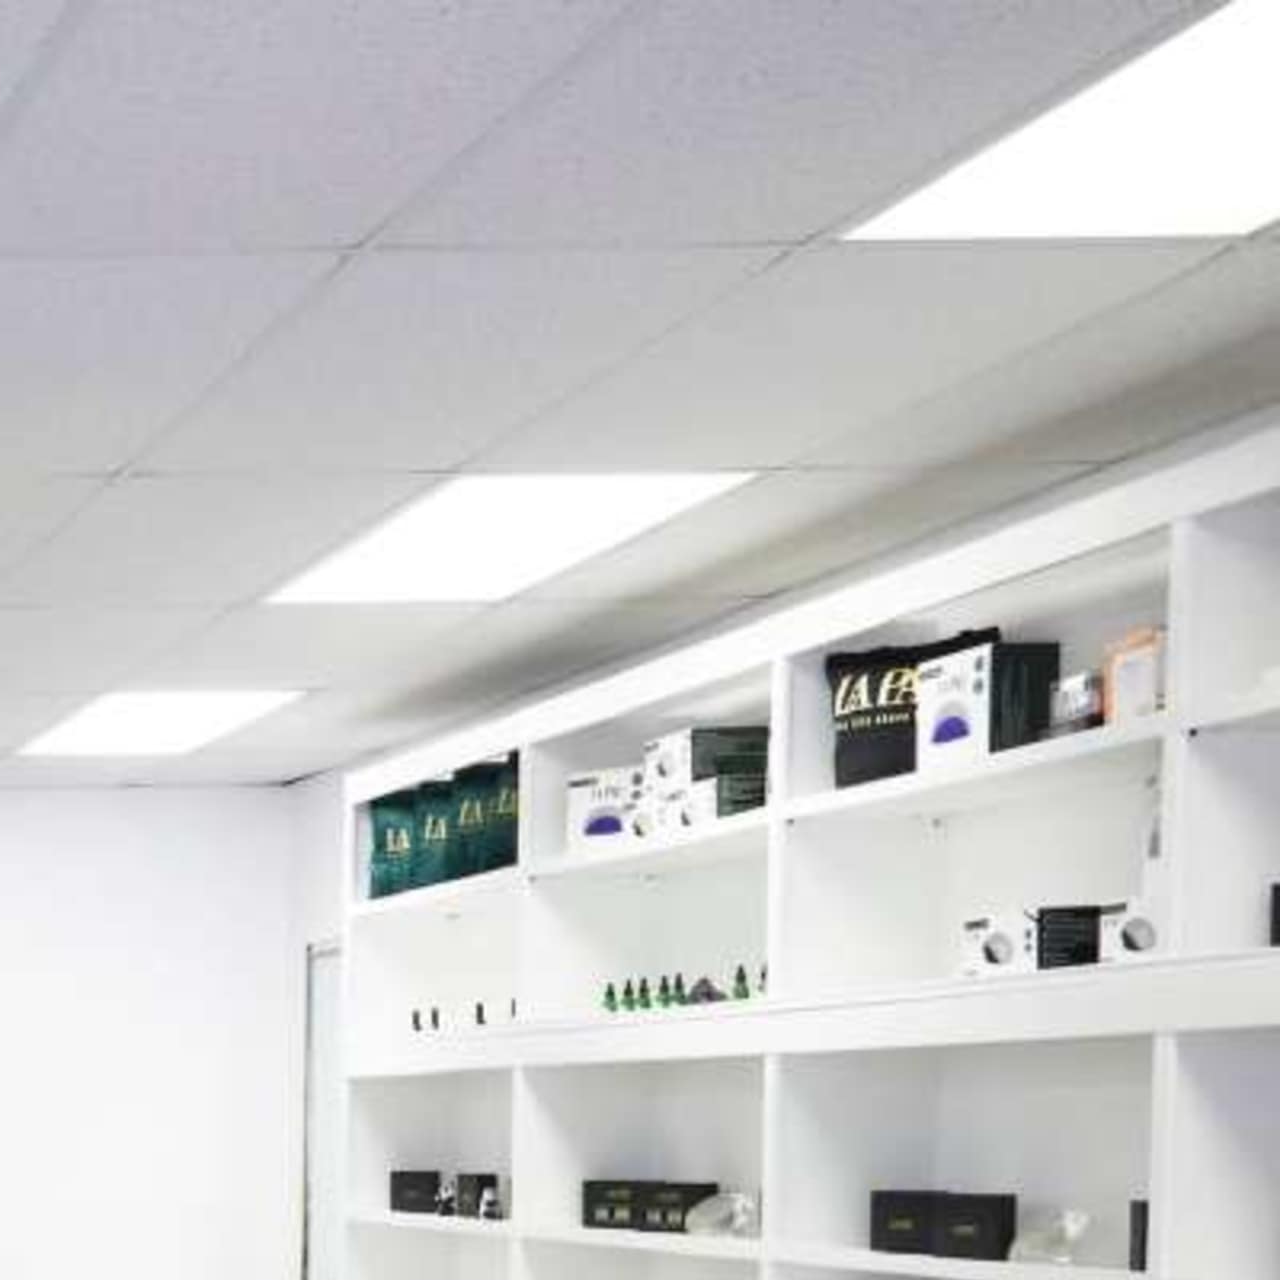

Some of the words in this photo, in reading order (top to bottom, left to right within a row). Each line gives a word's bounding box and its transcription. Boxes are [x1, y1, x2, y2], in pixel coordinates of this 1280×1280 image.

[834, 672, 874, 717] LA
[385, 827, 411, 852] LA
[424, 813, 448, 841] LA
